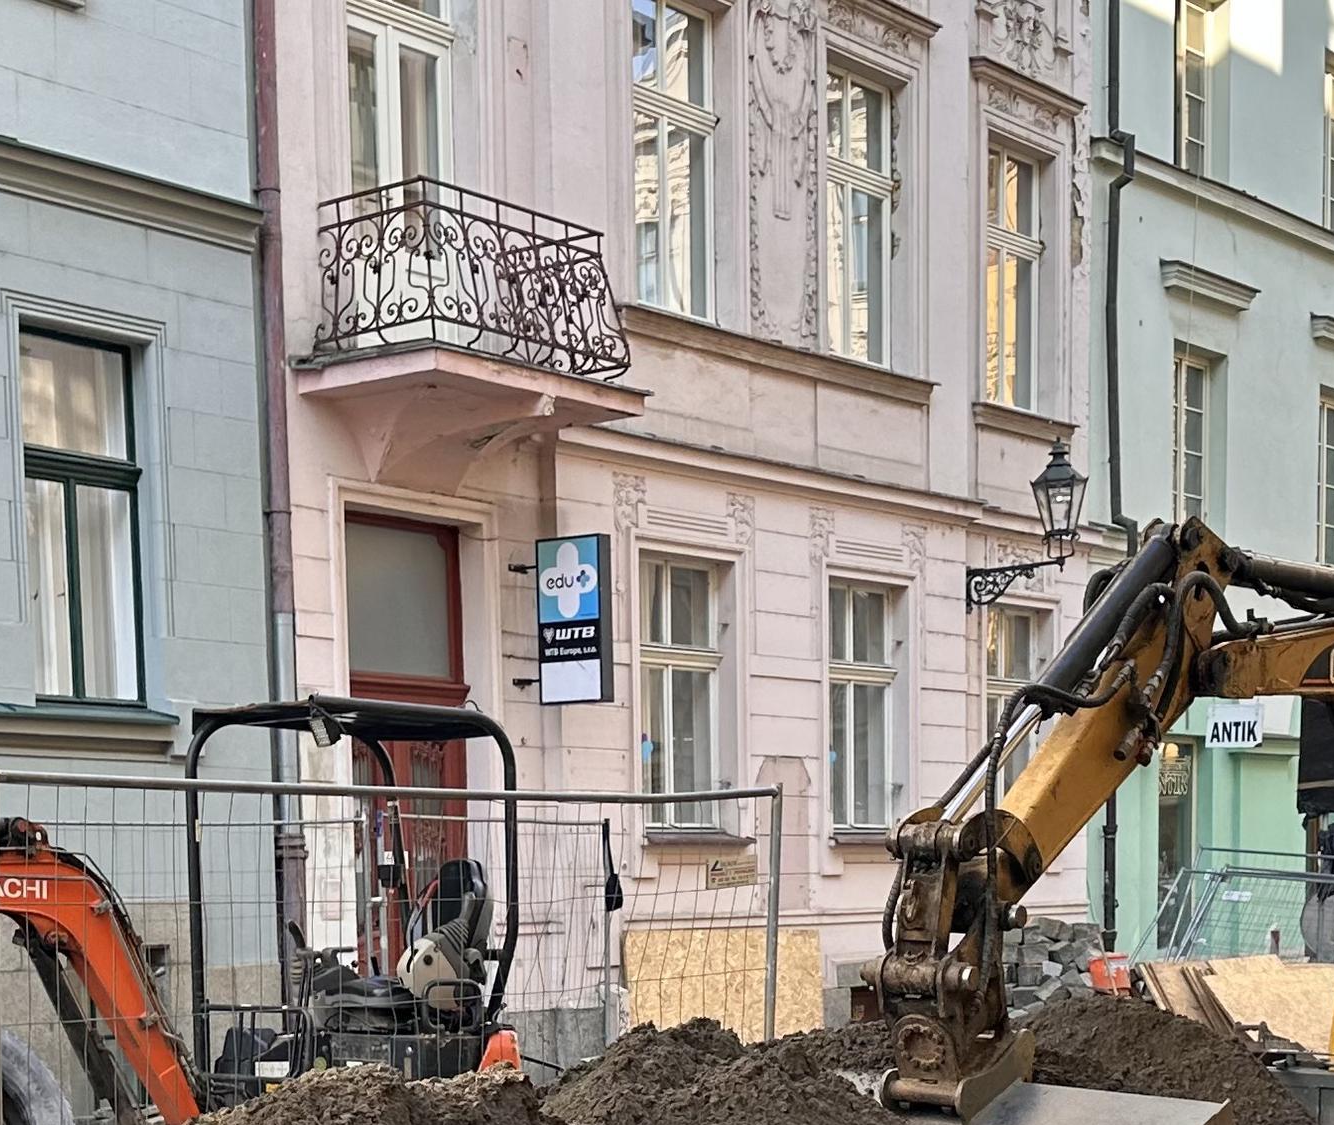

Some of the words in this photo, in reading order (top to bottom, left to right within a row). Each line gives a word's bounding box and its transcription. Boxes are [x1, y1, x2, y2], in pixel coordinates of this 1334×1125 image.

[546, 573, 574, 590] edu
[556, 626, 595, 641] WTB
[1210, 721, 1257, 743] ANTIK
